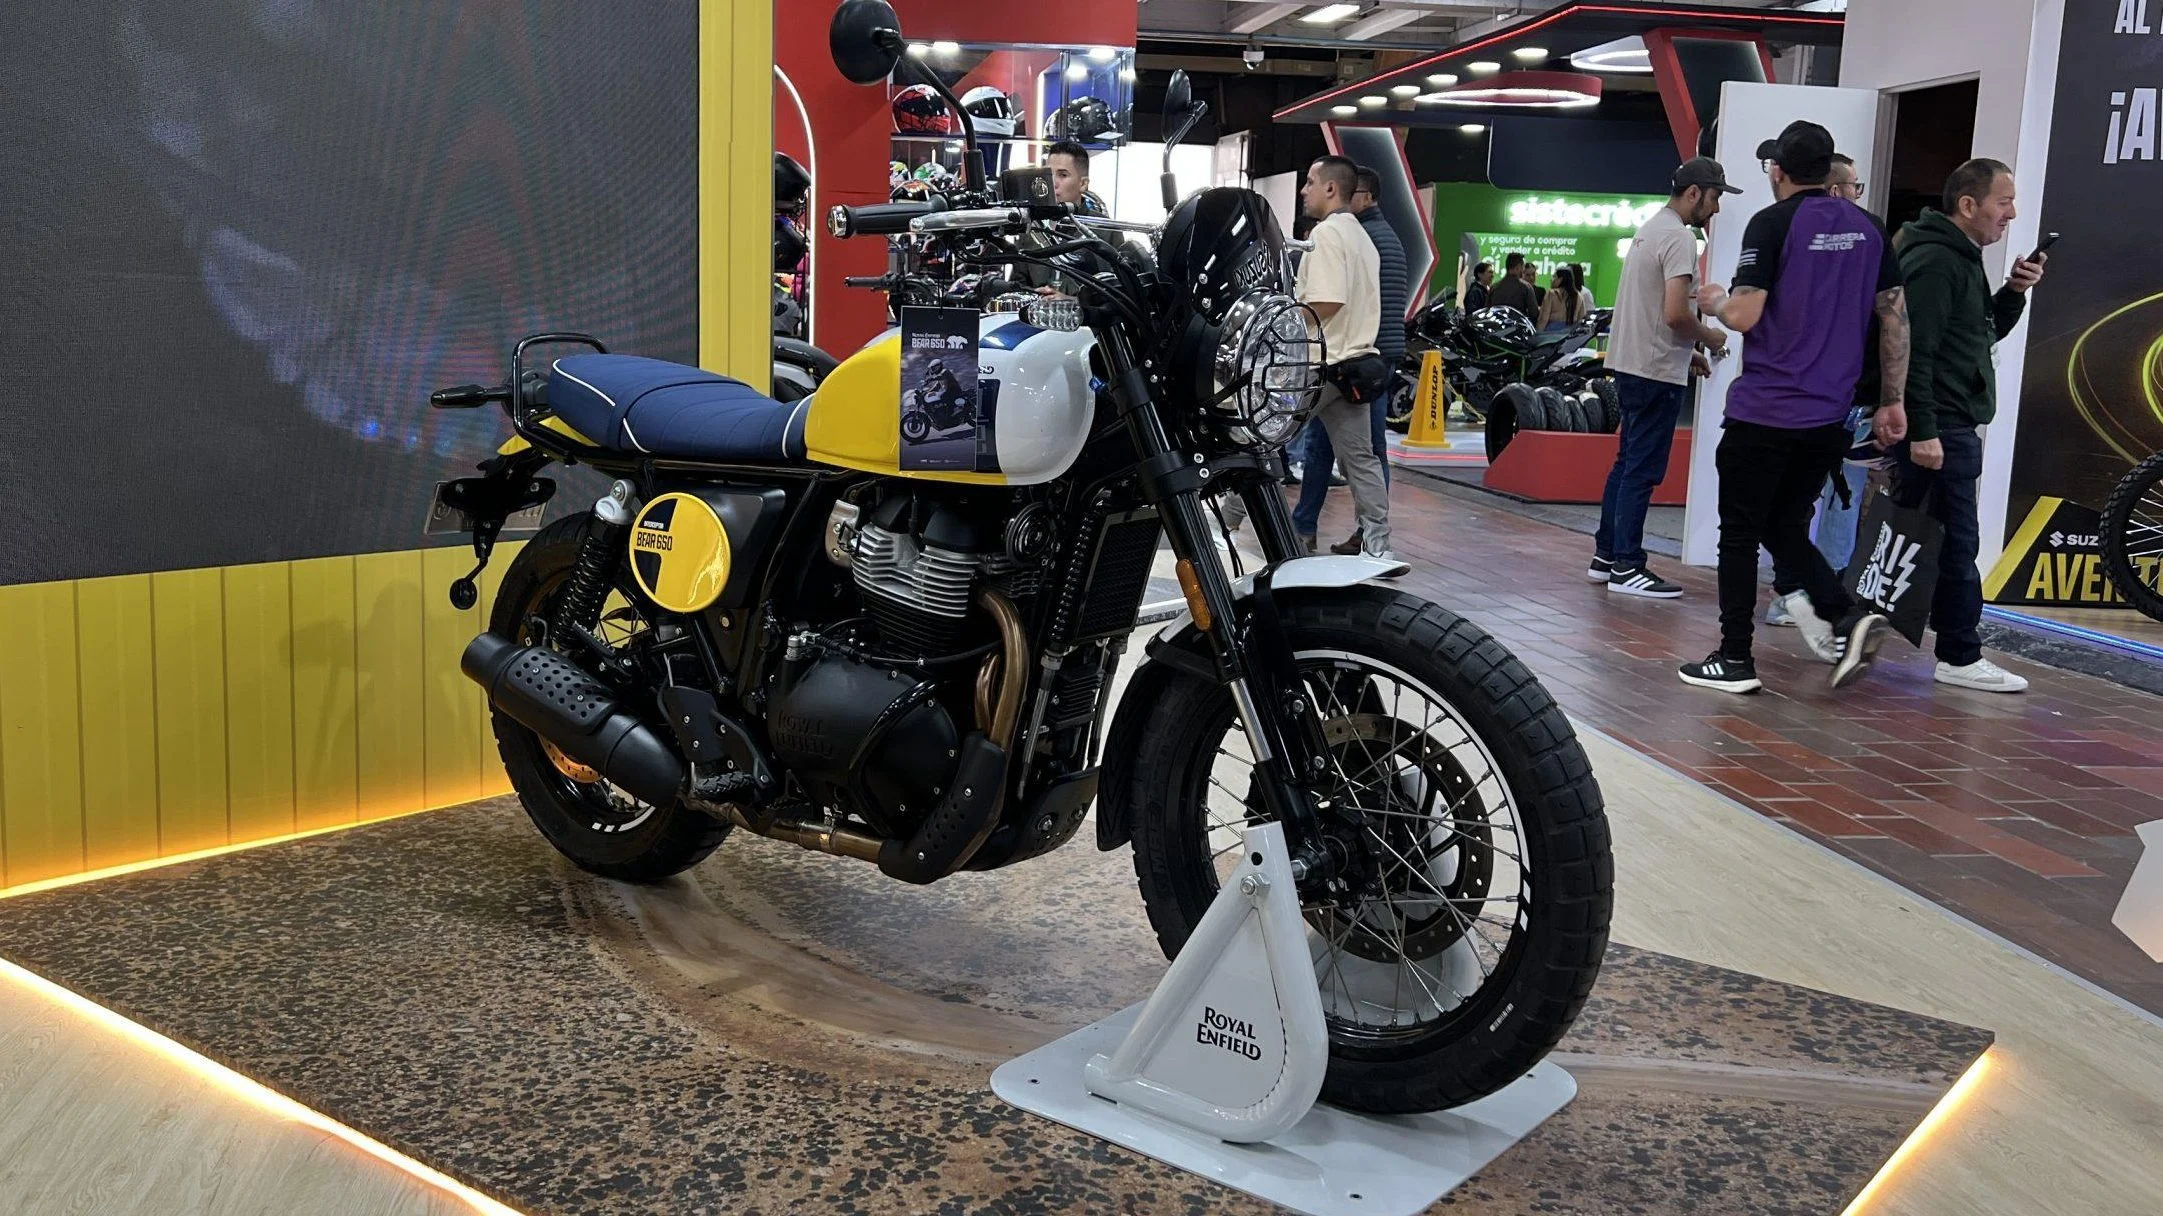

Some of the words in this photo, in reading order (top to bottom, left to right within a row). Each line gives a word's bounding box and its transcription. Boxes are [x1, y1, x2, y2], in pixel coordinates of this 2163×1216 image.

[2114, 0, 2150, 34] AL
[2103, 88, 2163, 164] ¡A
[1489, 235, 1521, 245] seguro
[1523, 235, 1536, 244] de
[1537, 236, 1577, 247] comprar
[1542, 246, 1576, 255] crédito
[912, 337, 930, 349] BEAR
[930, 338, 945, 349] 650
[637, 531, 656, 549] BEAR
[656, 534, 673, 551] 650
[2067, 534, 2099, 547] SUZ
[1204, 1005, 1257, 1040] ROYAL
[1196, 1023, 1262, 1061] ENFIELD
